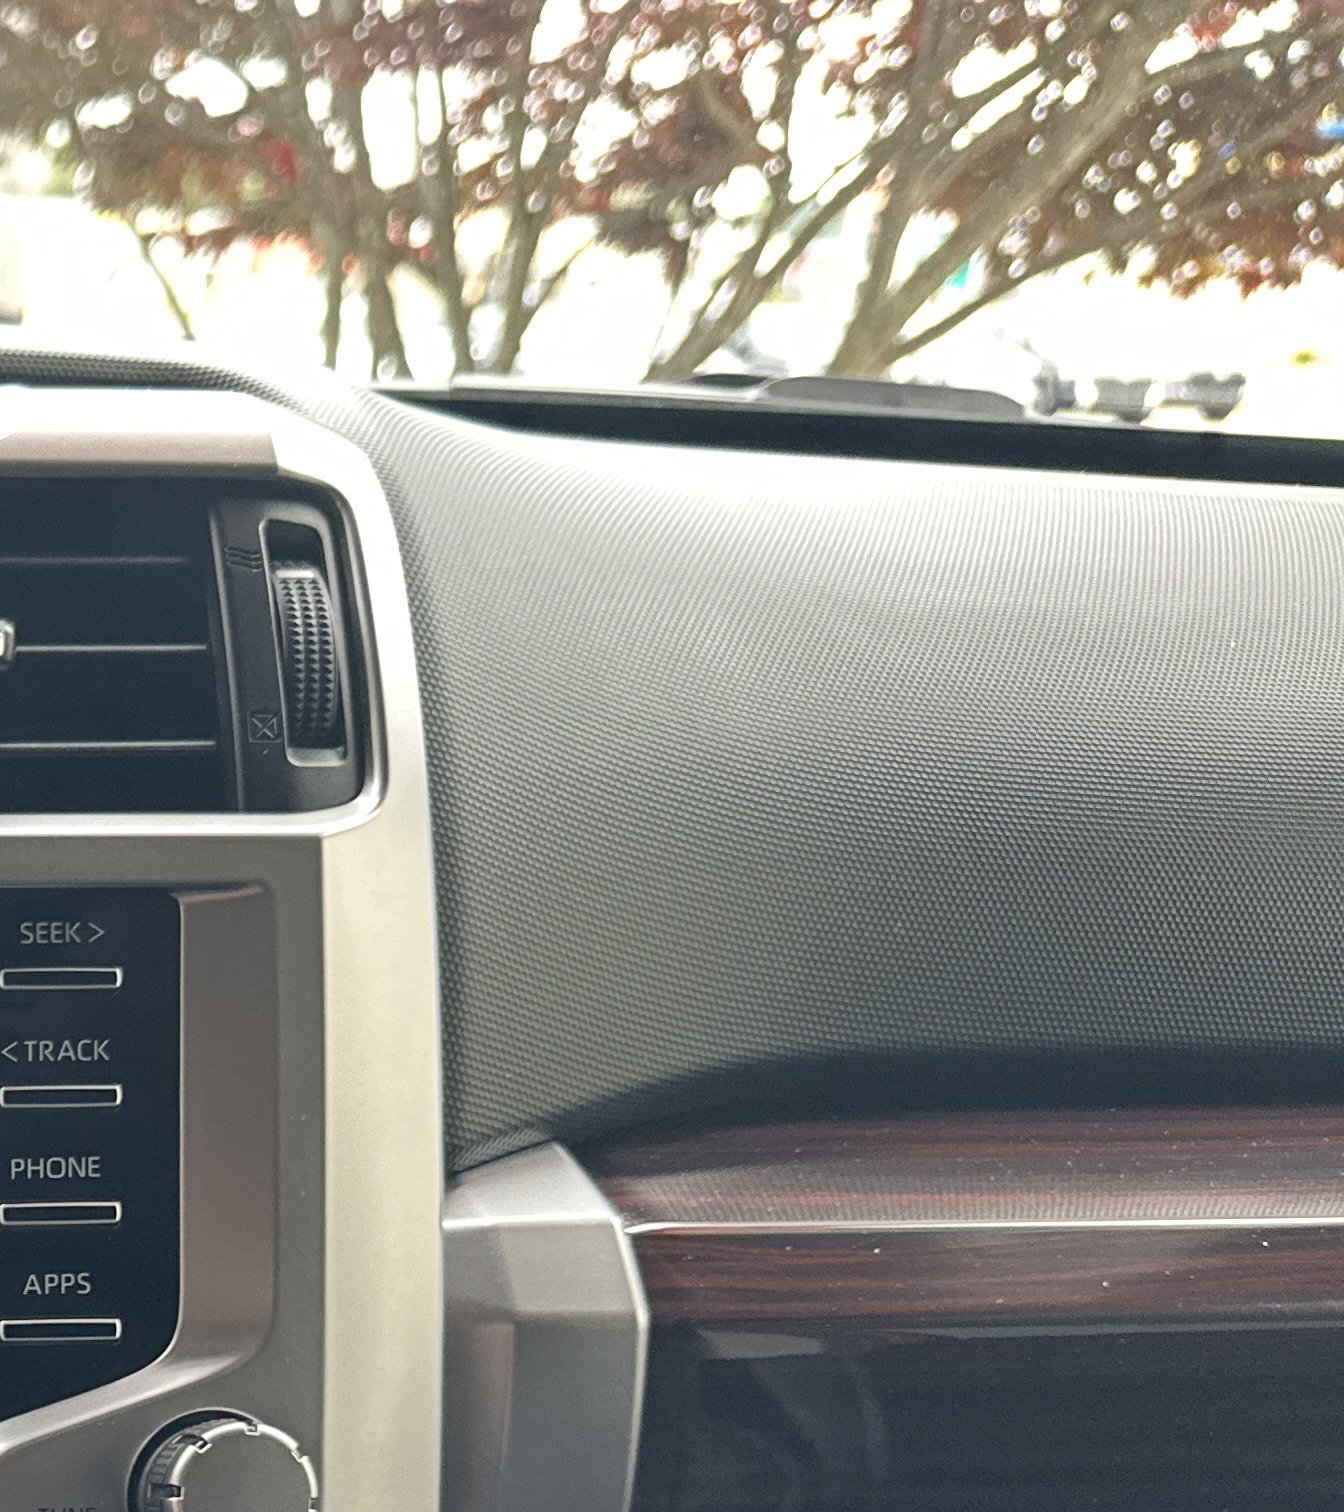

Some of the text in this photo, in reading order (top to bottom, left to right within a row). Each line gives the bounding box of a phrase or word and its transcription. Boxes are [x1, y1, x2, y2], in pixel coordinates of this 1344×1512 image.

[19, 922, 82, 945] SEEK
[23, 1039, 111, 1062] TRACK
[9, 1156, 102, 1181] PHONE
[22, 1272, 92, 1296] APPS
